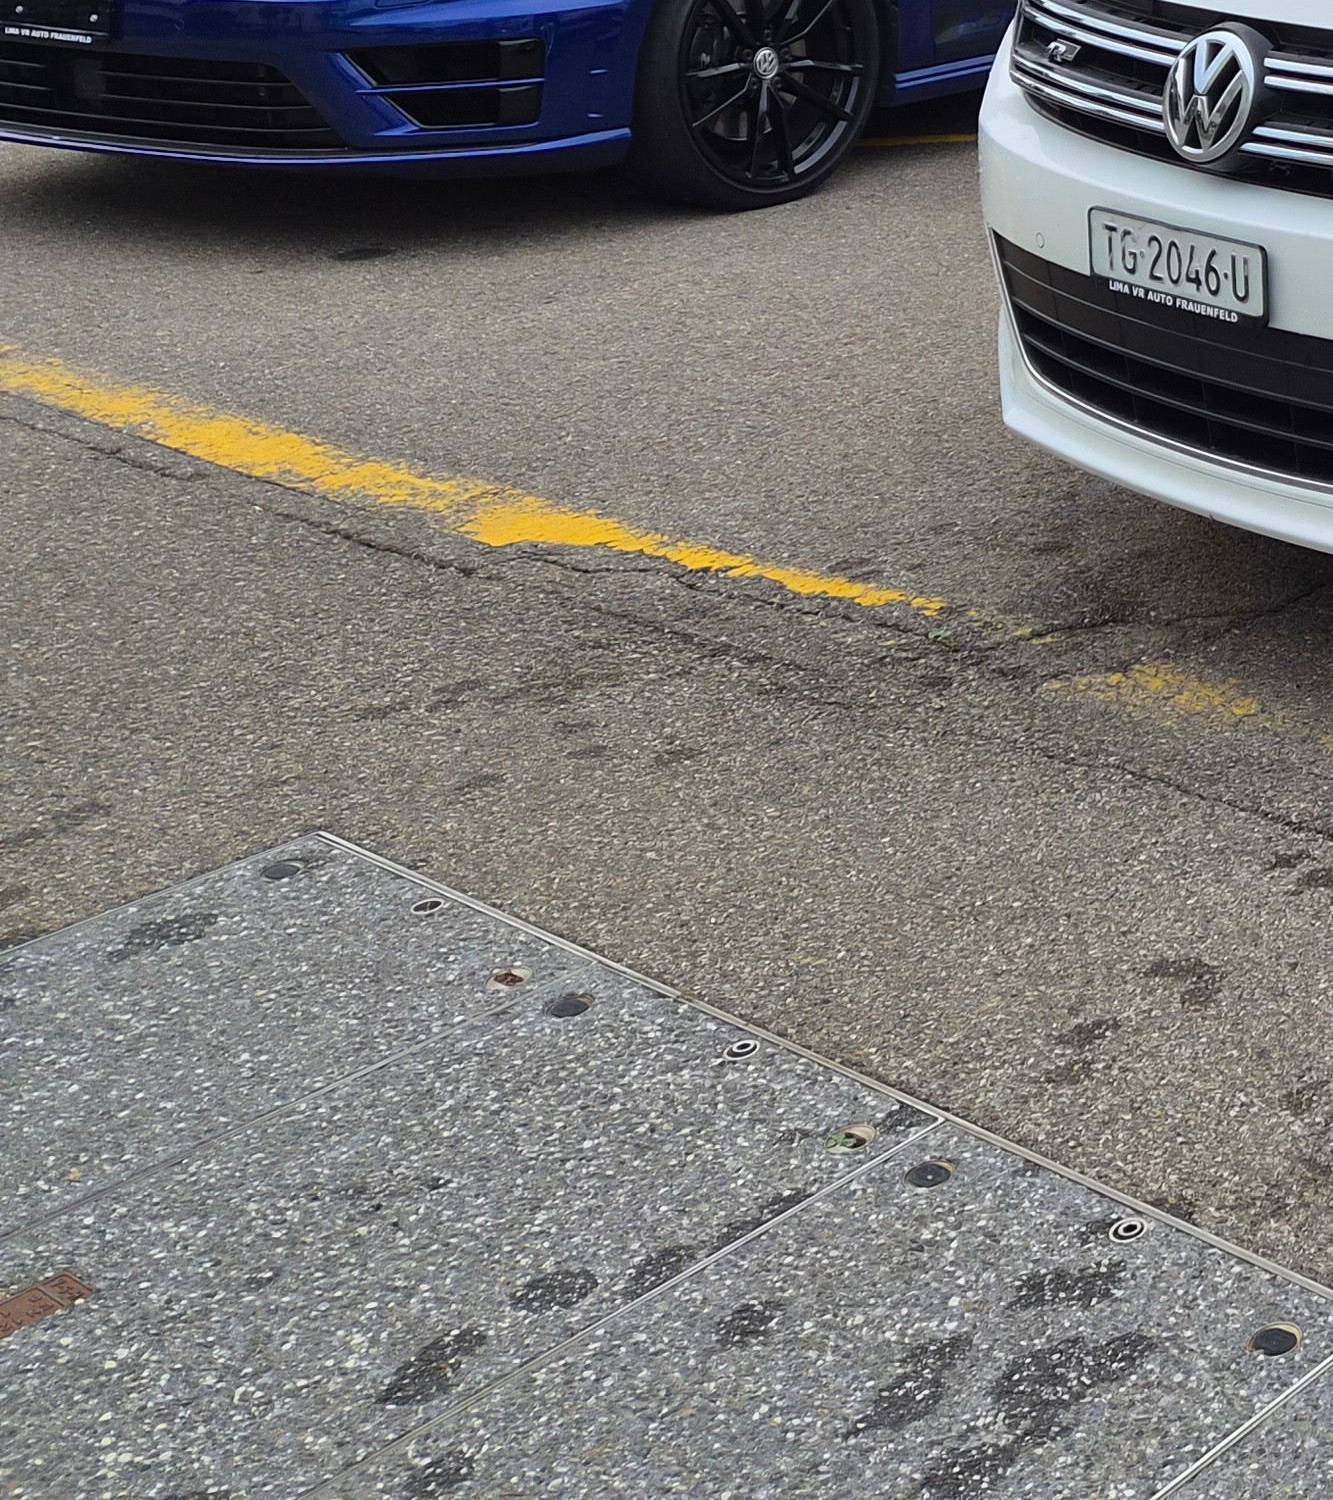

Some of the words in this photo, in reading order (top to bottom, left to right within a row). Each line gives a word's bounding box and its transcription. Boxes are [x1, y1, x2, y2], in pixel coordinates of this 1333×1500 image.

[31, 30, 49, 39] AUTO
[1162, 30, 1255, 163] VW
[1109, 280, 1130, 295] LIMA
[1132, 286, 1145, 299] VR
[1147, 290, 1173, 306] AUTO
[1175, 298, 1238, 323] FRAUENFELD
